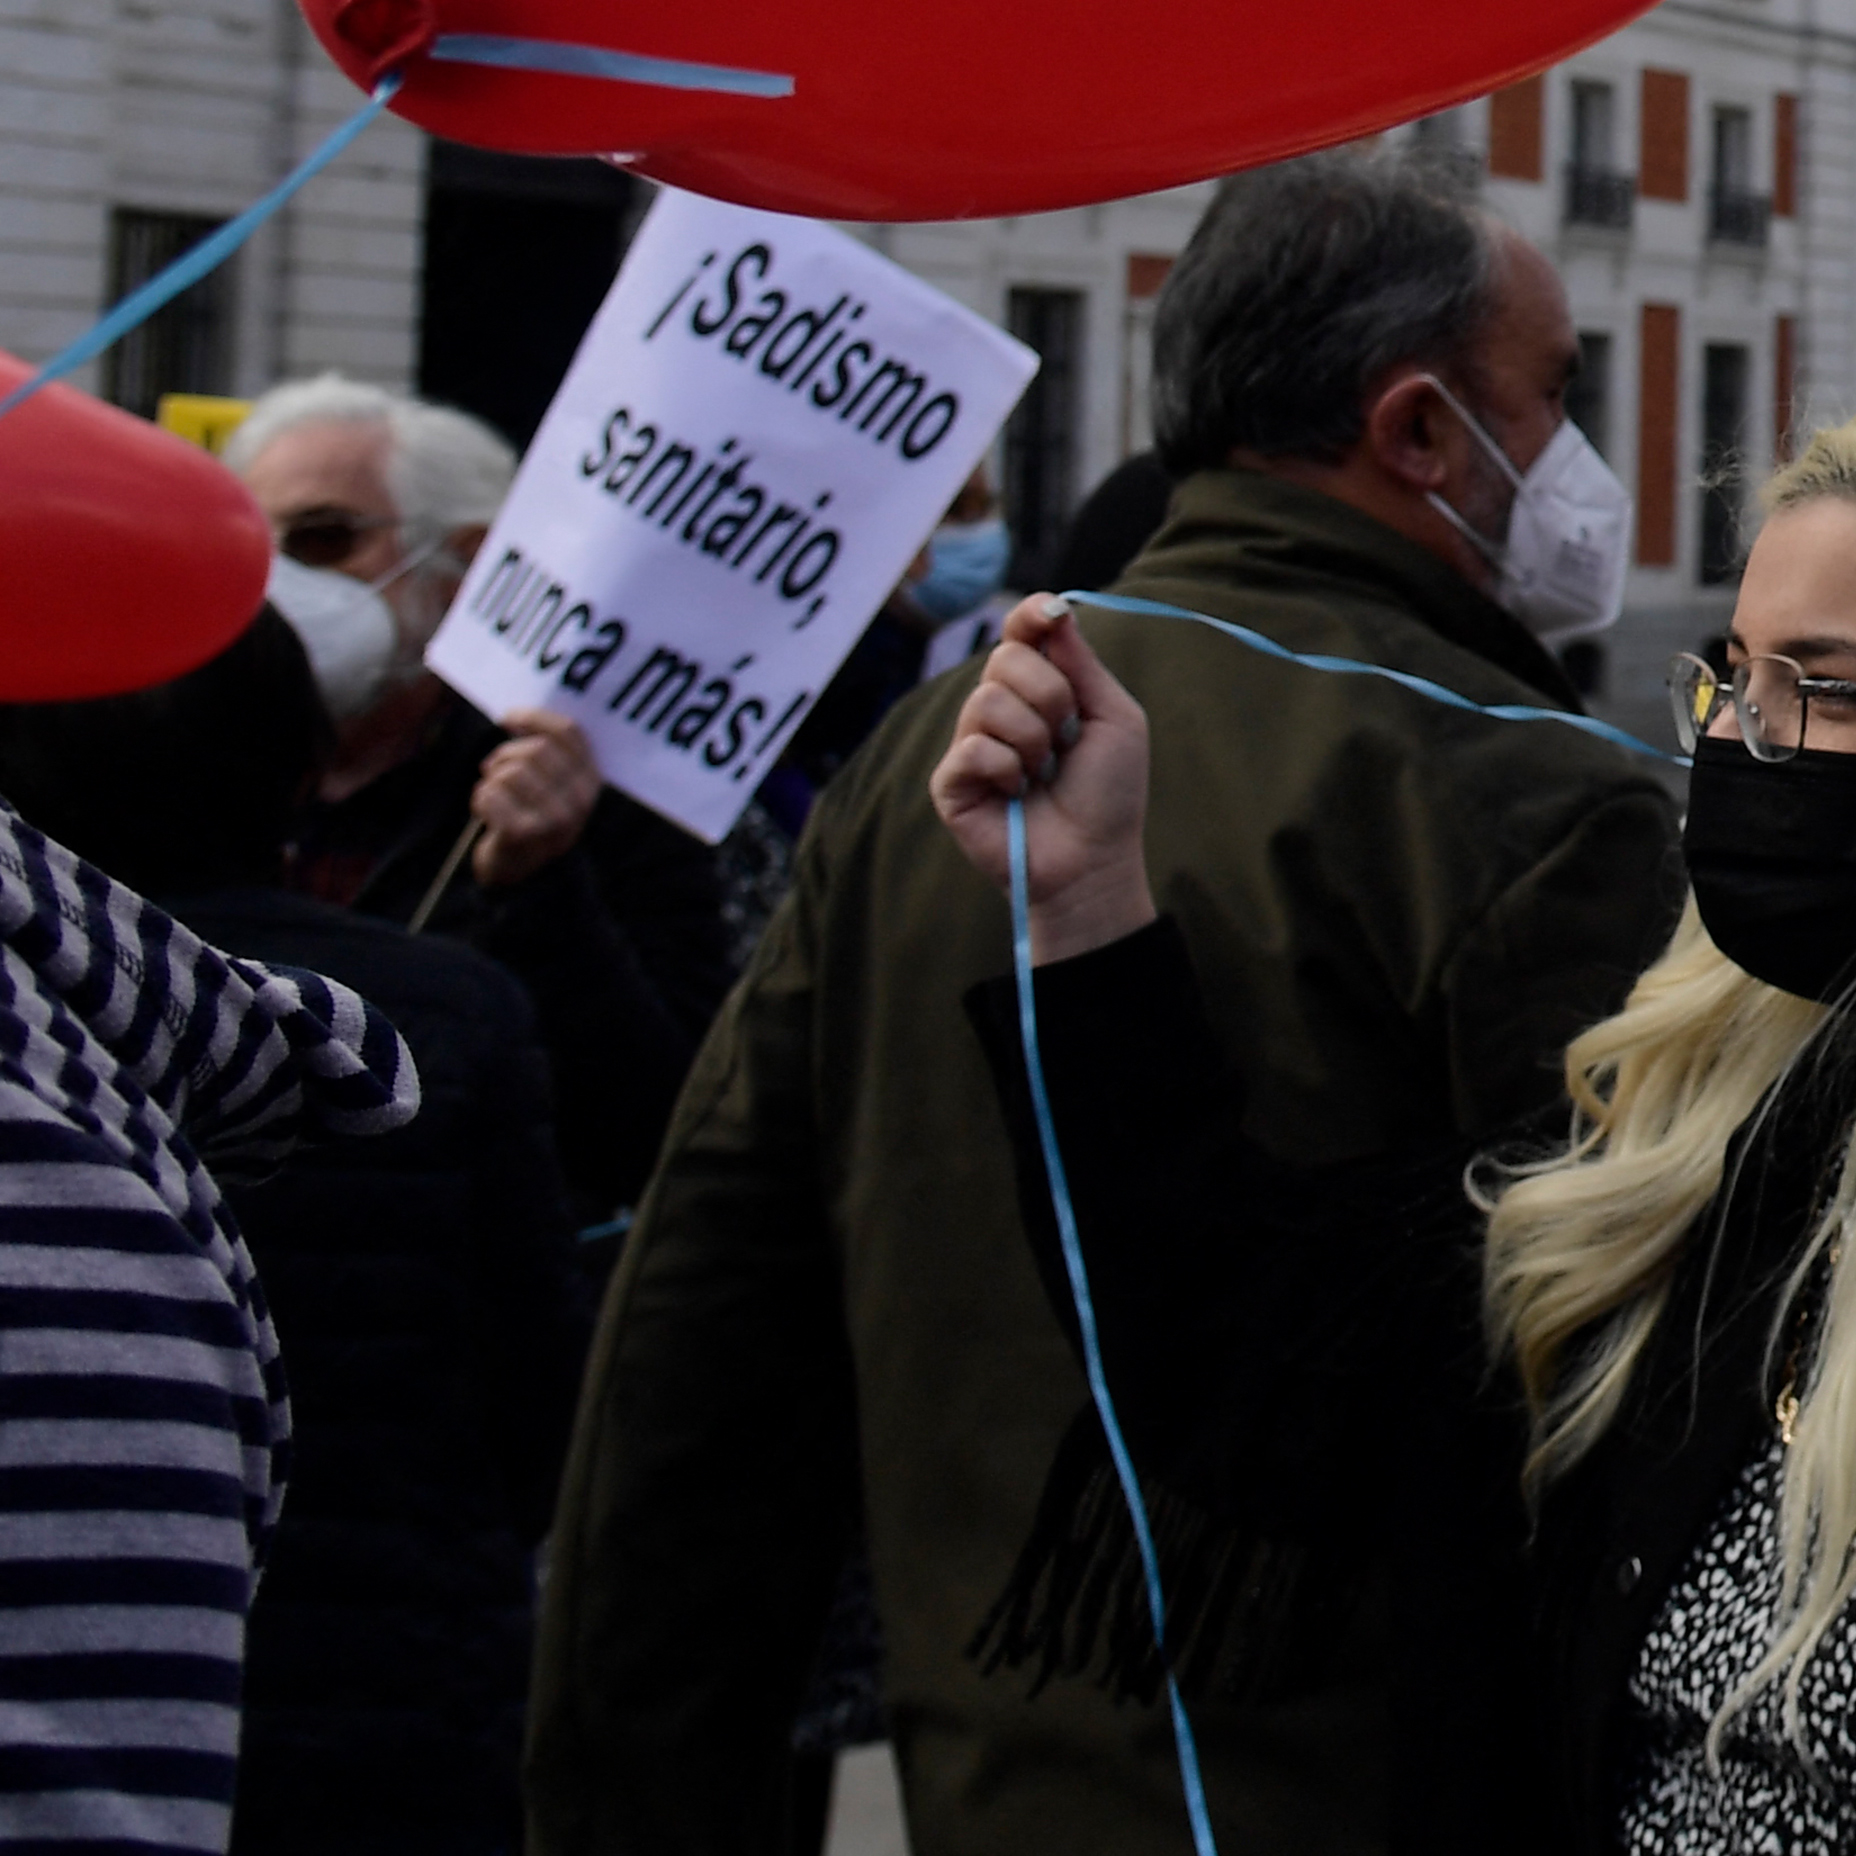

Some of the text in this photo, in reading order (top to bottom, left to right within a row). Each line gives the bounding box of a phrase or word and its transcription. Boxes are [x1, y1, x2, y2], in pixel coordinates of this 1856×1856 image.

[648, 243, 959, 462] ¡Sadismo
[583, 410, 842, 629] sanitario,
[472, 548, 808, 782] nunca más!
